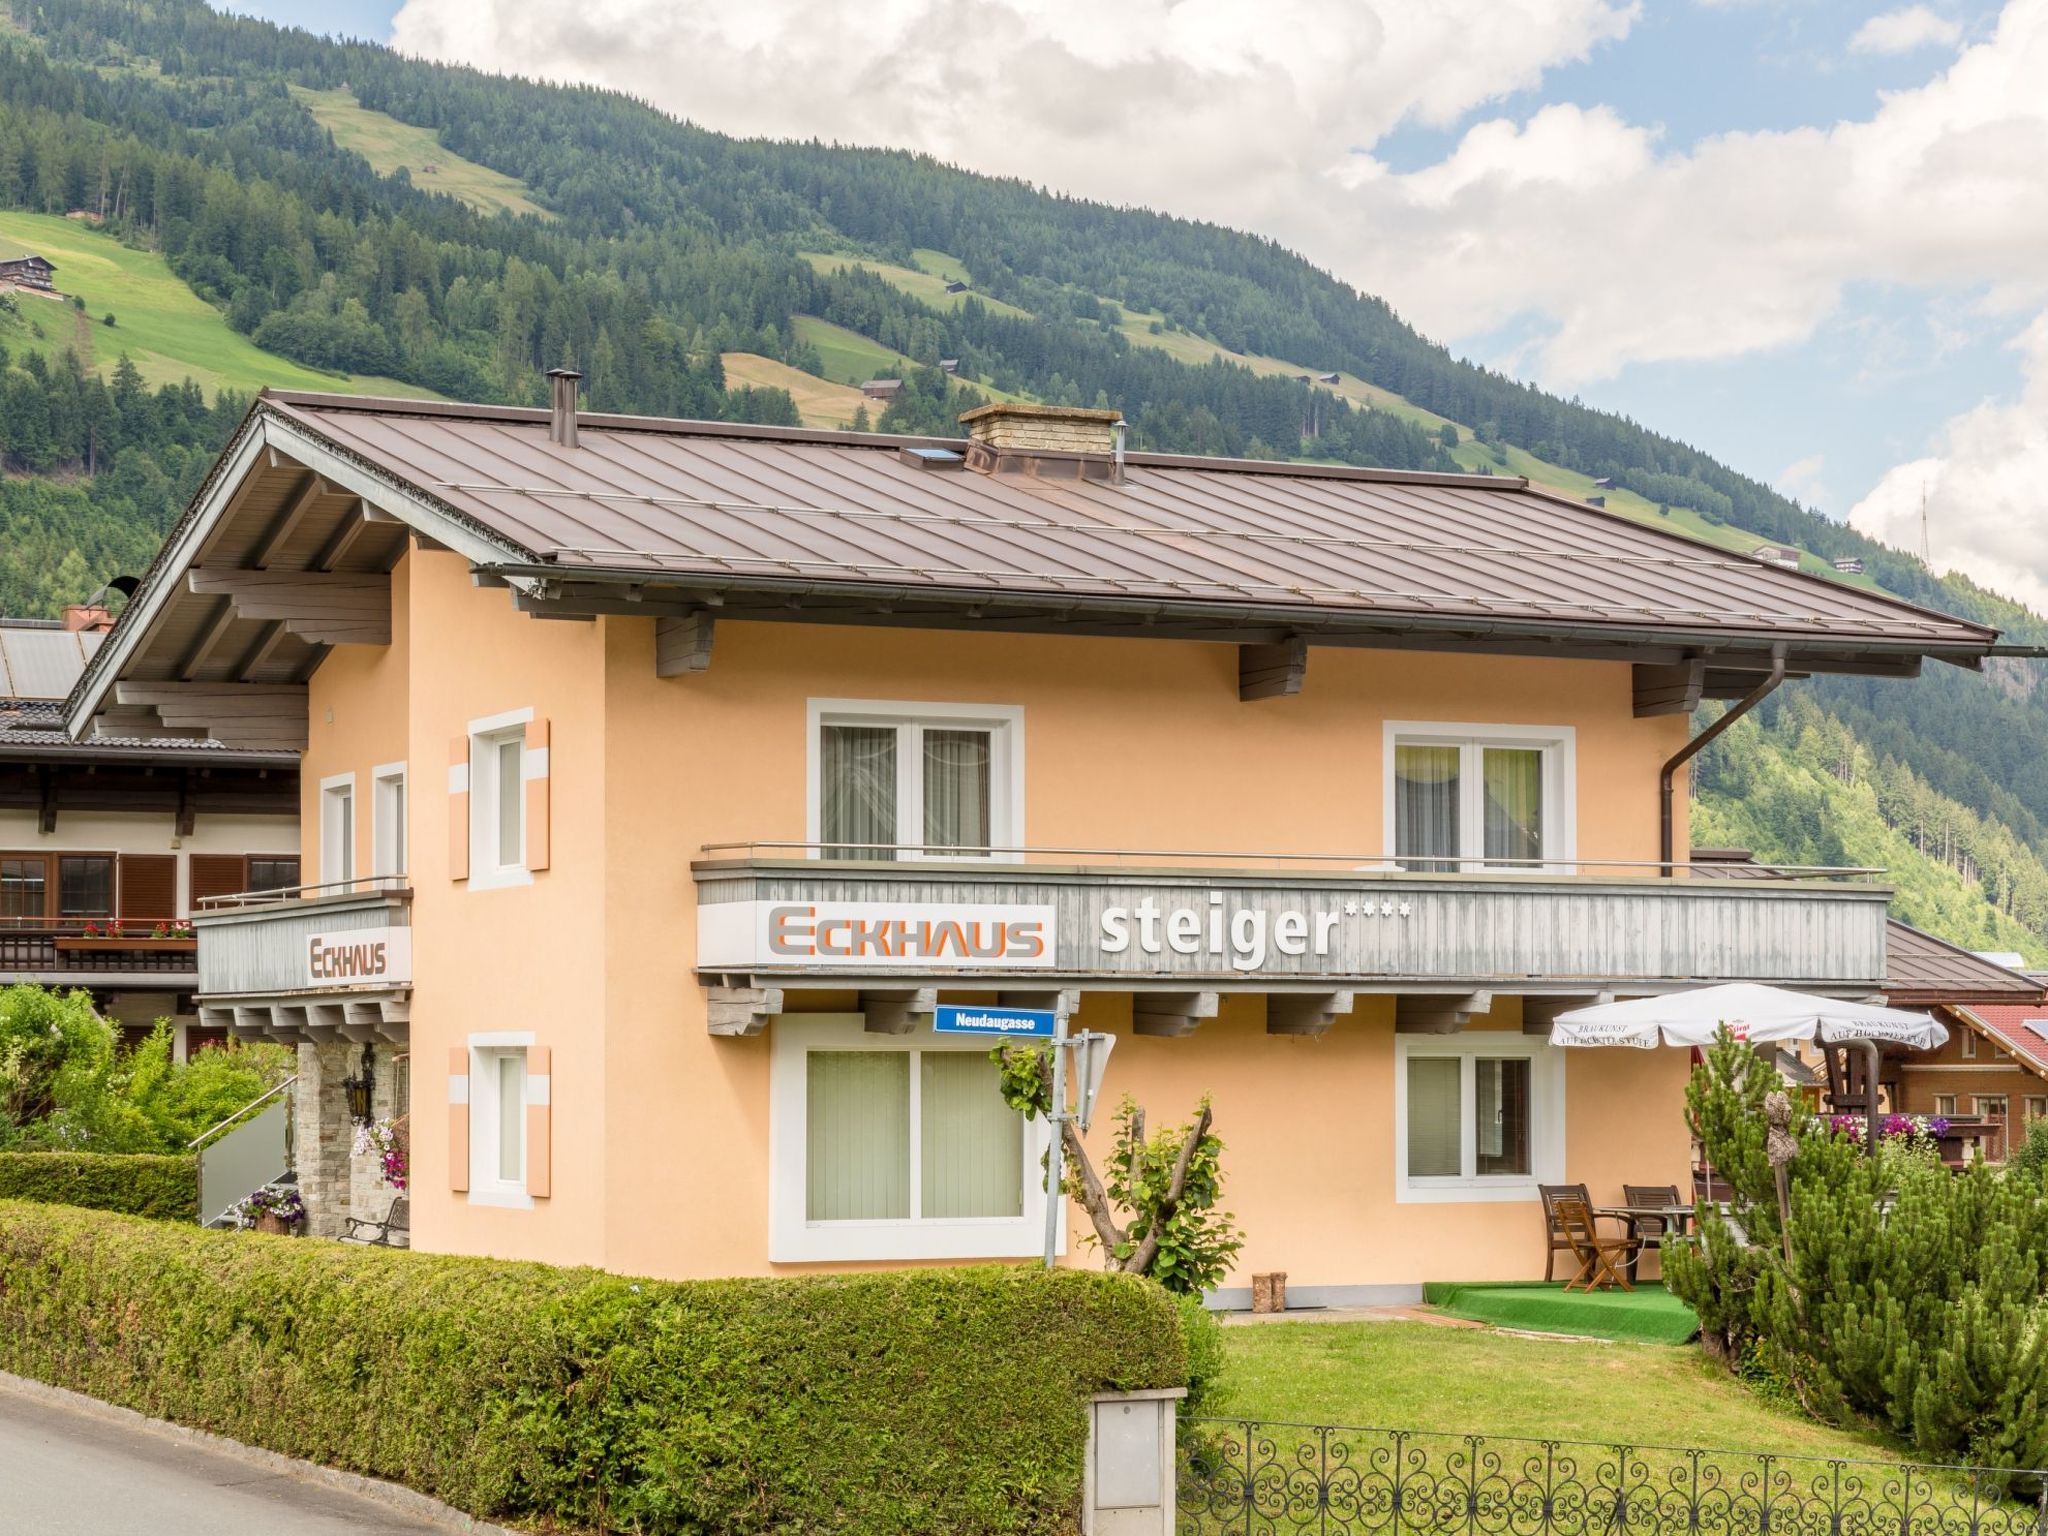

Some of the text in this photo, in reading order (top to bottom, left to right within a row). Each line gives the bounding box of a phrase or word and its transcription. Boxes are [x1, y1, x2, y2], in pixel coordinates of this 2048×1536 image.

[768, 906, 1044, 958] ECKHAUS
[1100, 891, 1340, 971] steiger
[310, 937, 387, 978] ECKHAUS
[955, 1012, 1036, 1031] Neudaugasse
[1578, 1024, 1628, 1033] BRAUKUNST
